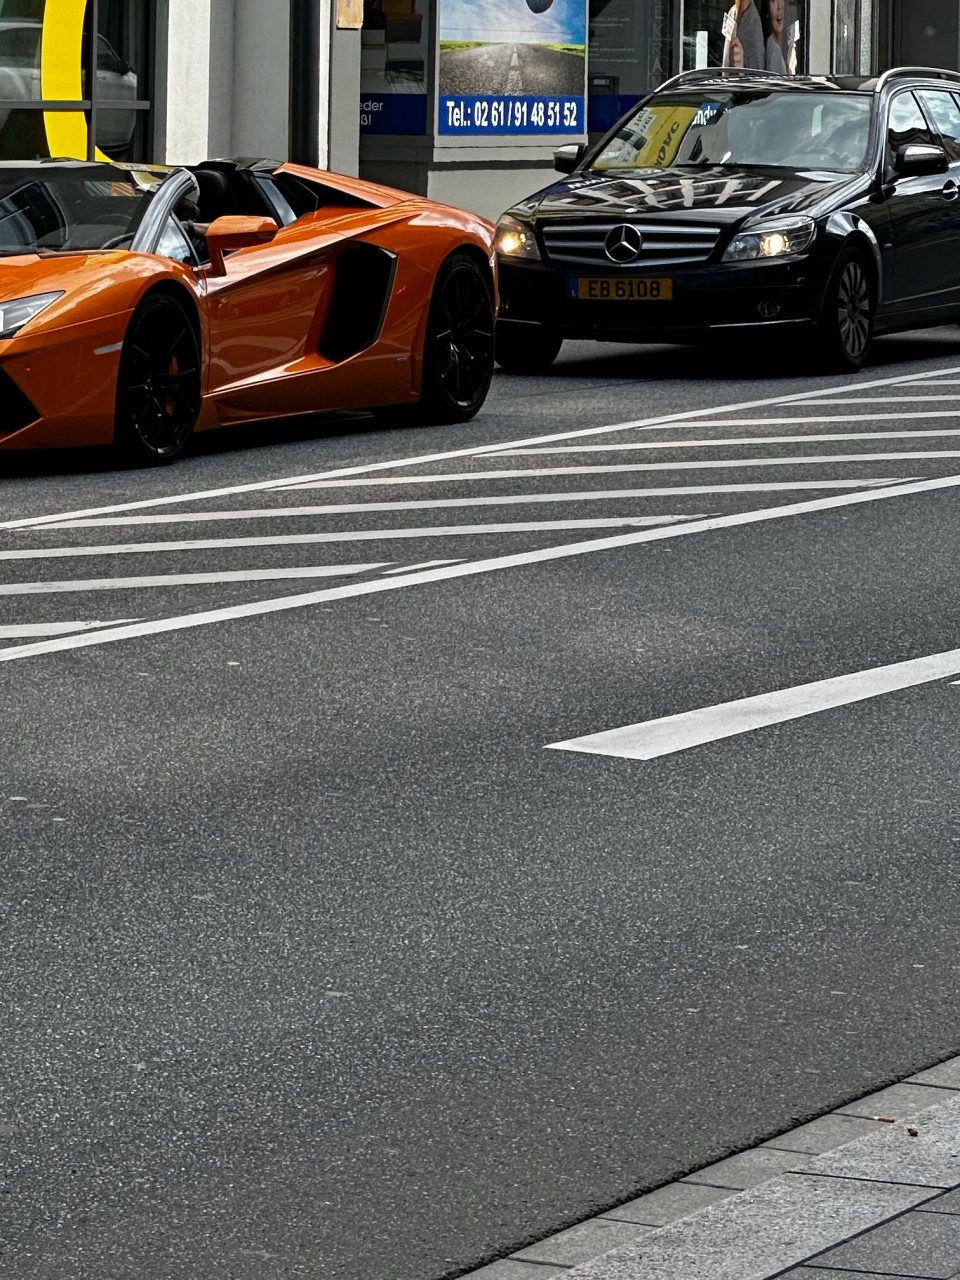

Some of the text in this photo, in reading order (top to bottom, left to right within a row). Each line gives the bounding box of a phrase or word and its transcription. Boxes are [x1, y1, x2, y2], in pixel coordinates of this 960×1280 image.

[446, 100, 471, 127] Tel.:
[474, 100, 489, 127] 02
[491, 100, 505, 127] 61
[514, 100, 527, 127] 91
[530, 100, 545, 127] 48
[547, 100, 560, 127] 51
[563, 100, 577, 127] 52
[588, 280, 610, 298] EB
[615, 280, 660, 298] 6108
